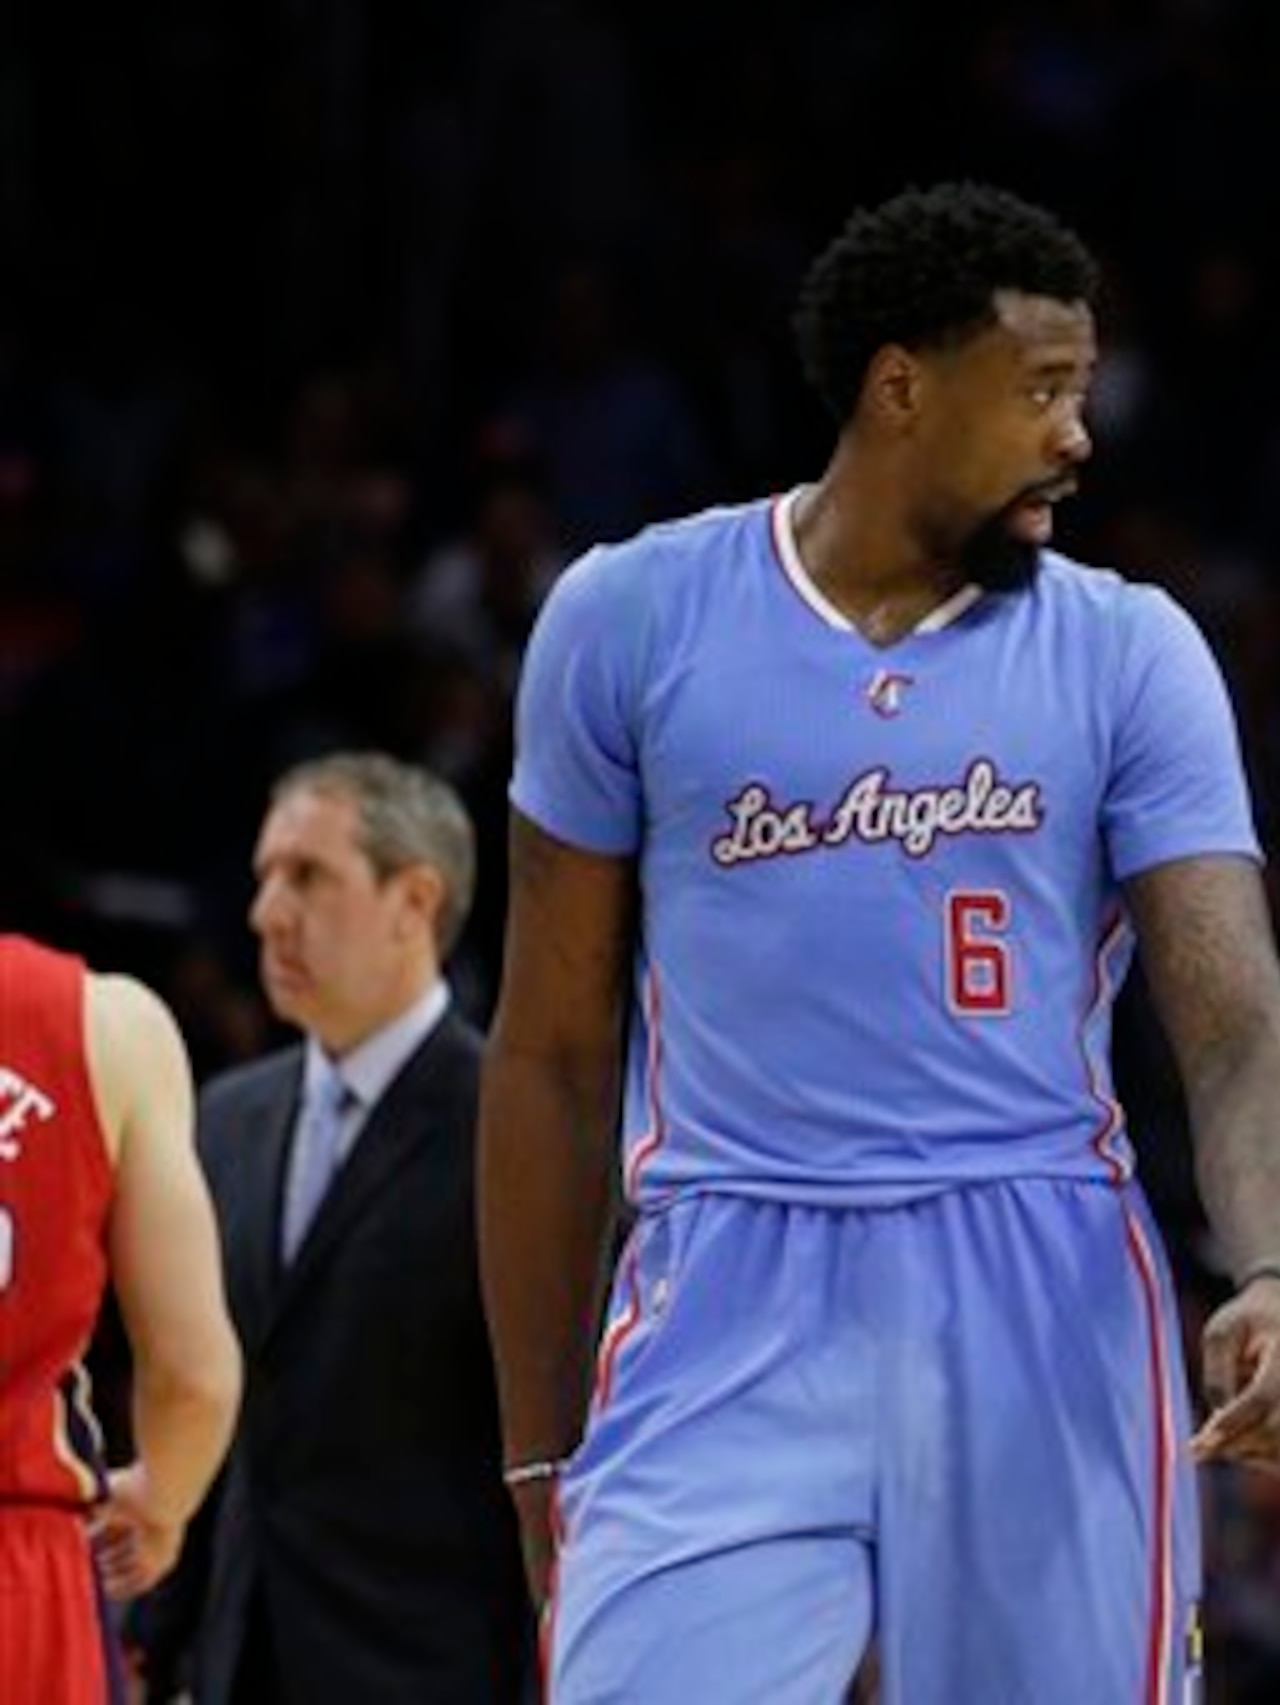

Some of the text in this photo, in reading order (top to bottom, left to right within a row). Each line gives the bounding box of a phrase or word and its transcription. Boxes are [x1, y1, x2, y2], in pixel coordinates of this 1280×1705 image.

[713, 756, 1043, 867] Los Angeles
[944, 889, 1012, 1017] 6
